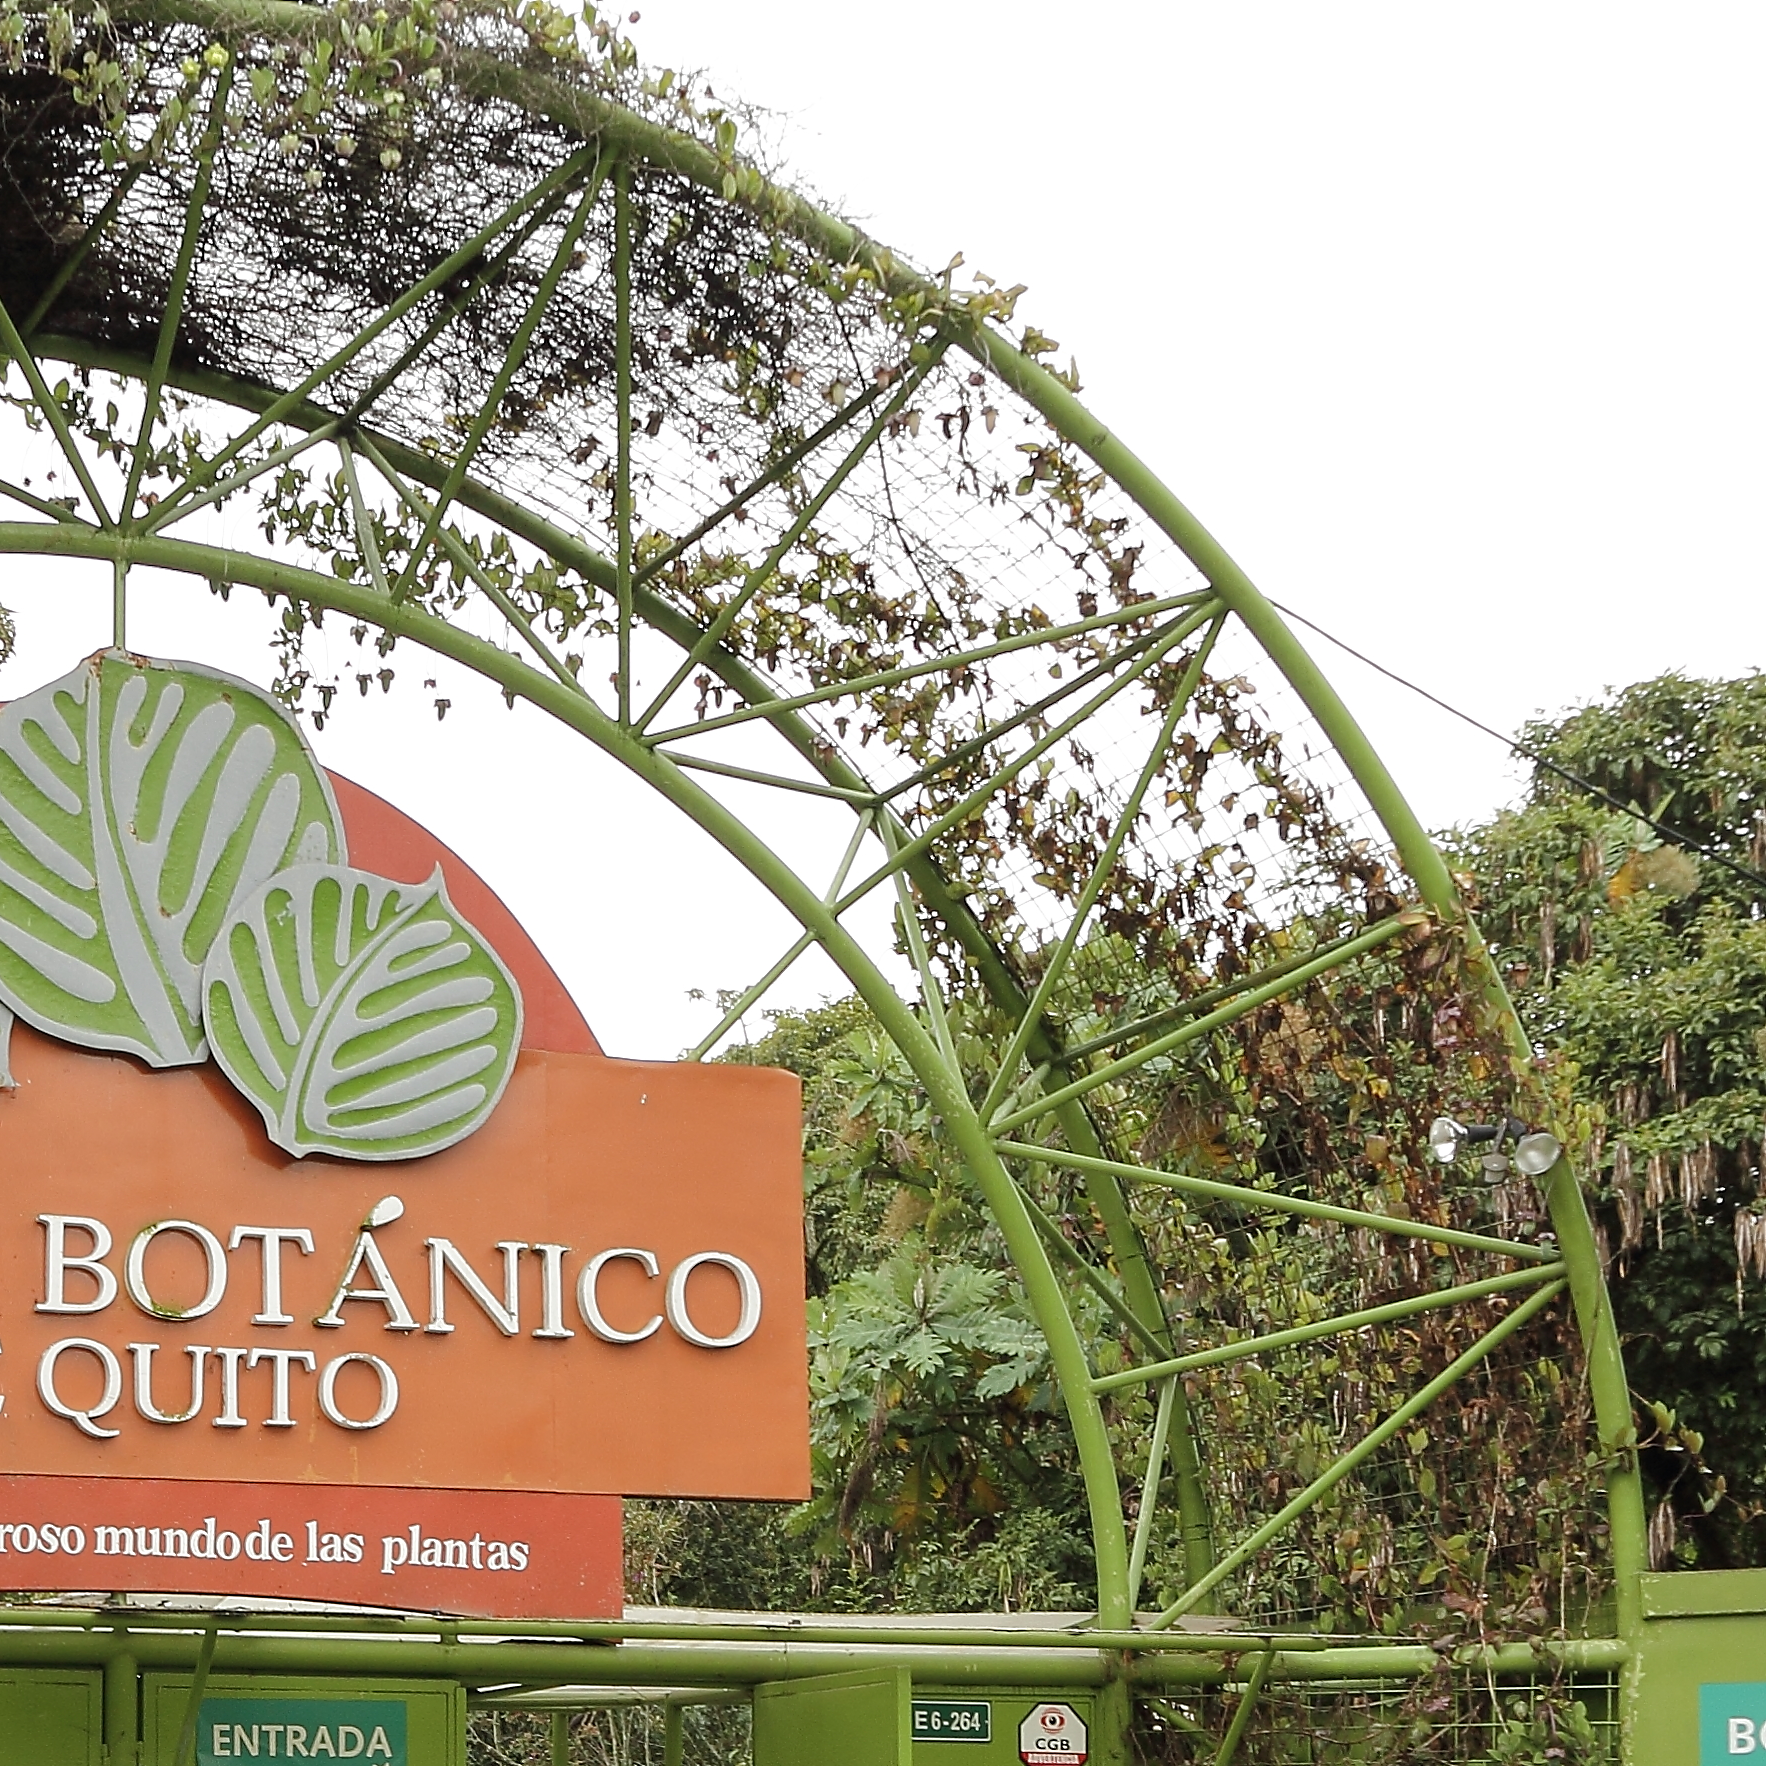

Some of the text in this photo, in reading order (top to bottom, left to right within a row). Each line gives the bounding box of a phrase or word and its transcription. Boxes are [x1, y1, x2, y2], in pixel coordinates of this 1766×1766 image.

[35, 1194, 763, 1350] BOTÁNICO
[35, 1336, 401, 1440] QUITO
[93, 1517, 240, 1561] mundo
[244, 1519, 294, 1562] de
[305, 1520, 366, 1563] las
[380, 1524, 531, 1575] plantas
[212, 1723, 394, 1759] ENTRADA
[1035, 1737, 1071, 1751] CGB
